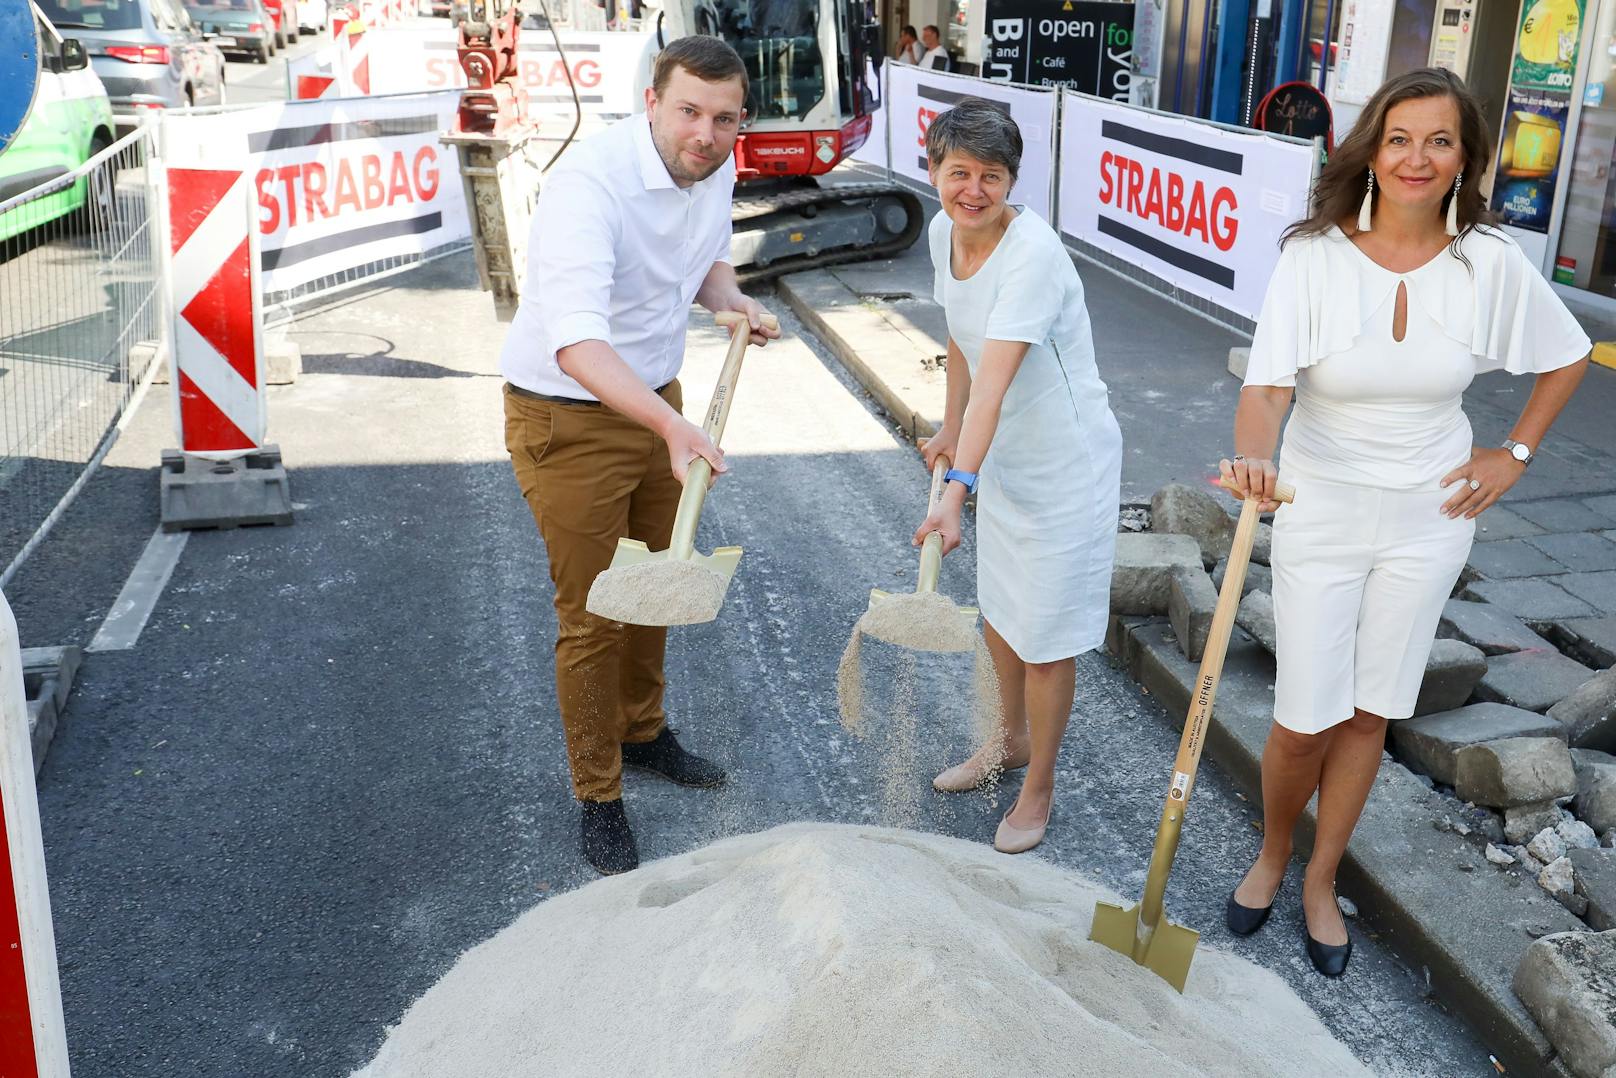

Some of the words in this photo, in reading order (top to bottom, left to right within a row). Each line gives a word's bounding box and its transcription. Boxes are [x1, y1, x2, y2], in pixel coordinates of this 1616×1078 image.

[1038, 19, 1094, 42] open
[996, 45, 1020, 58] and
[1042, 56, 1066, 68] Café
[425, 57, 602, 89] STBAG
[1547, 72, 1572, 86] LOTTO
[254, 144, 440, 236] STRABAG
[1098, 150, 1239, 252] STRABAG
[1503, 201, 1538, 216] MILLIONEN
[1512, 194, 1531, 206] EURO
[1198, 675, 1214, 706] OFFNER
